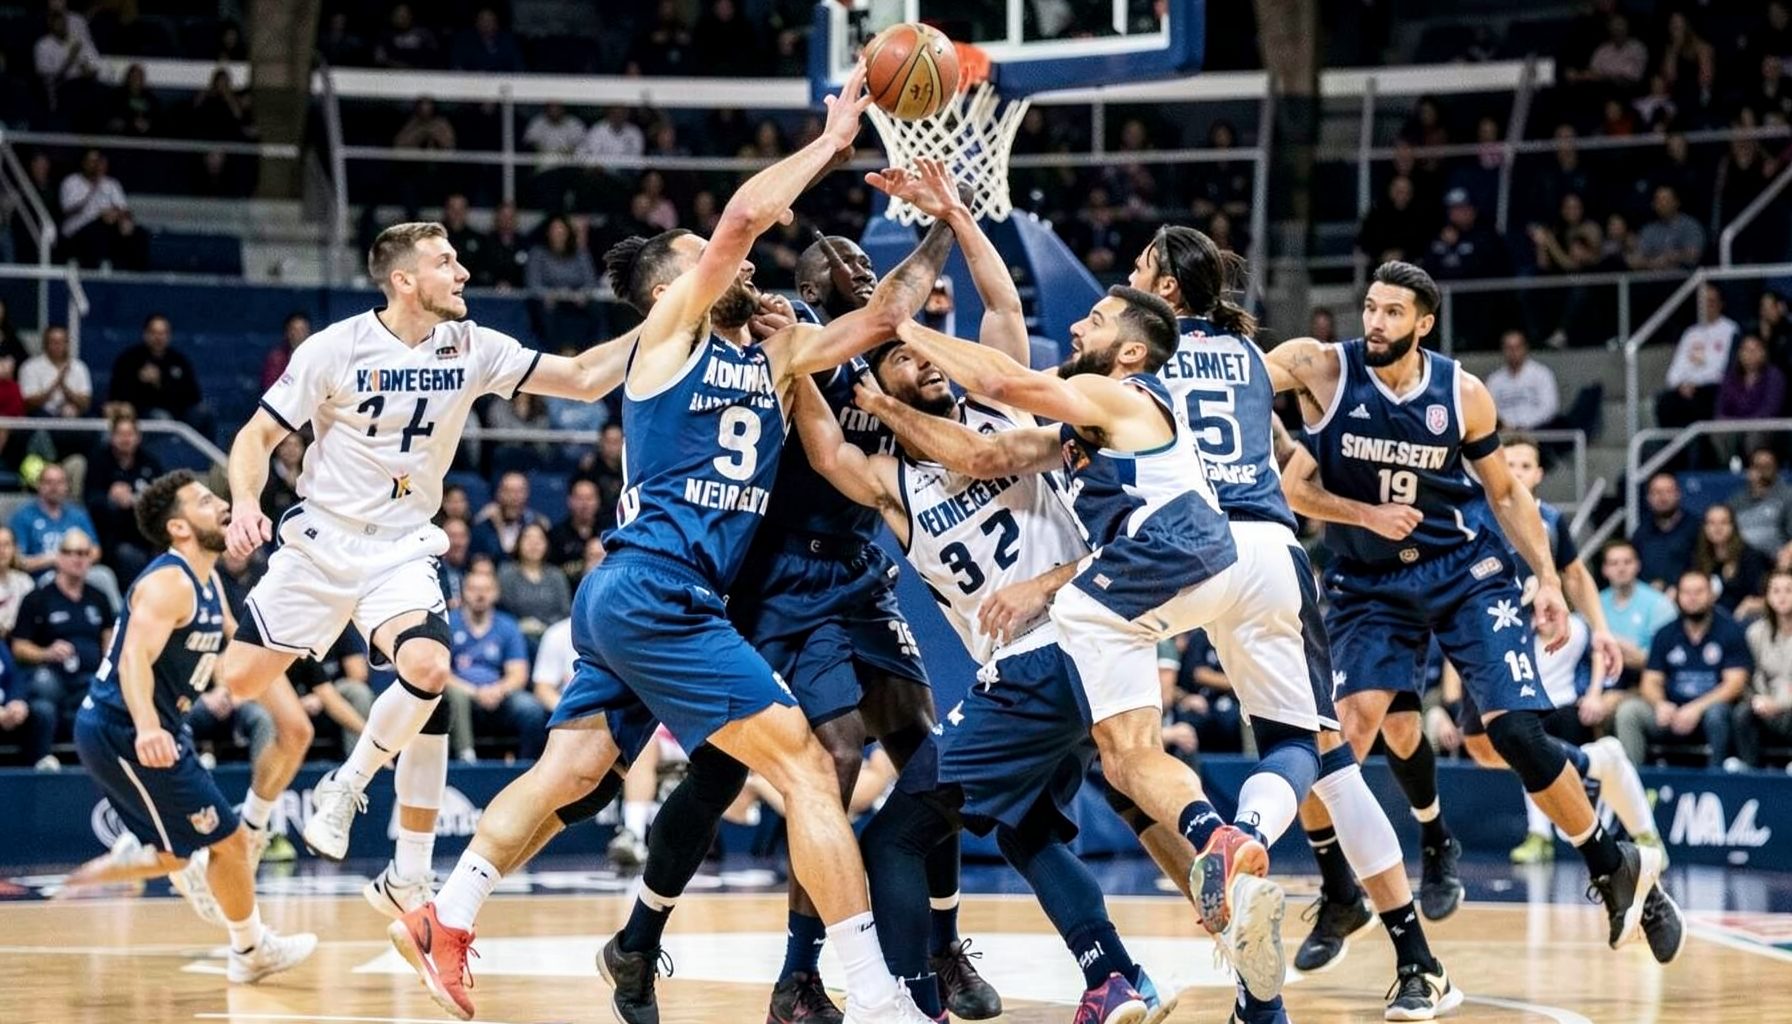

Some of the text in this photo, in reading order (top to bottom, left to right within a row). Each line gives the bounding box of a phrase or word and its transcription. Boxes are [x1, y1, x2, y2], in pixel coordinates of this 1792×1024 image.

[713, 405, 762, 481] 9
[1185, 388, 1236, 456] 5
[1378, 468, 1419, 505] 19
